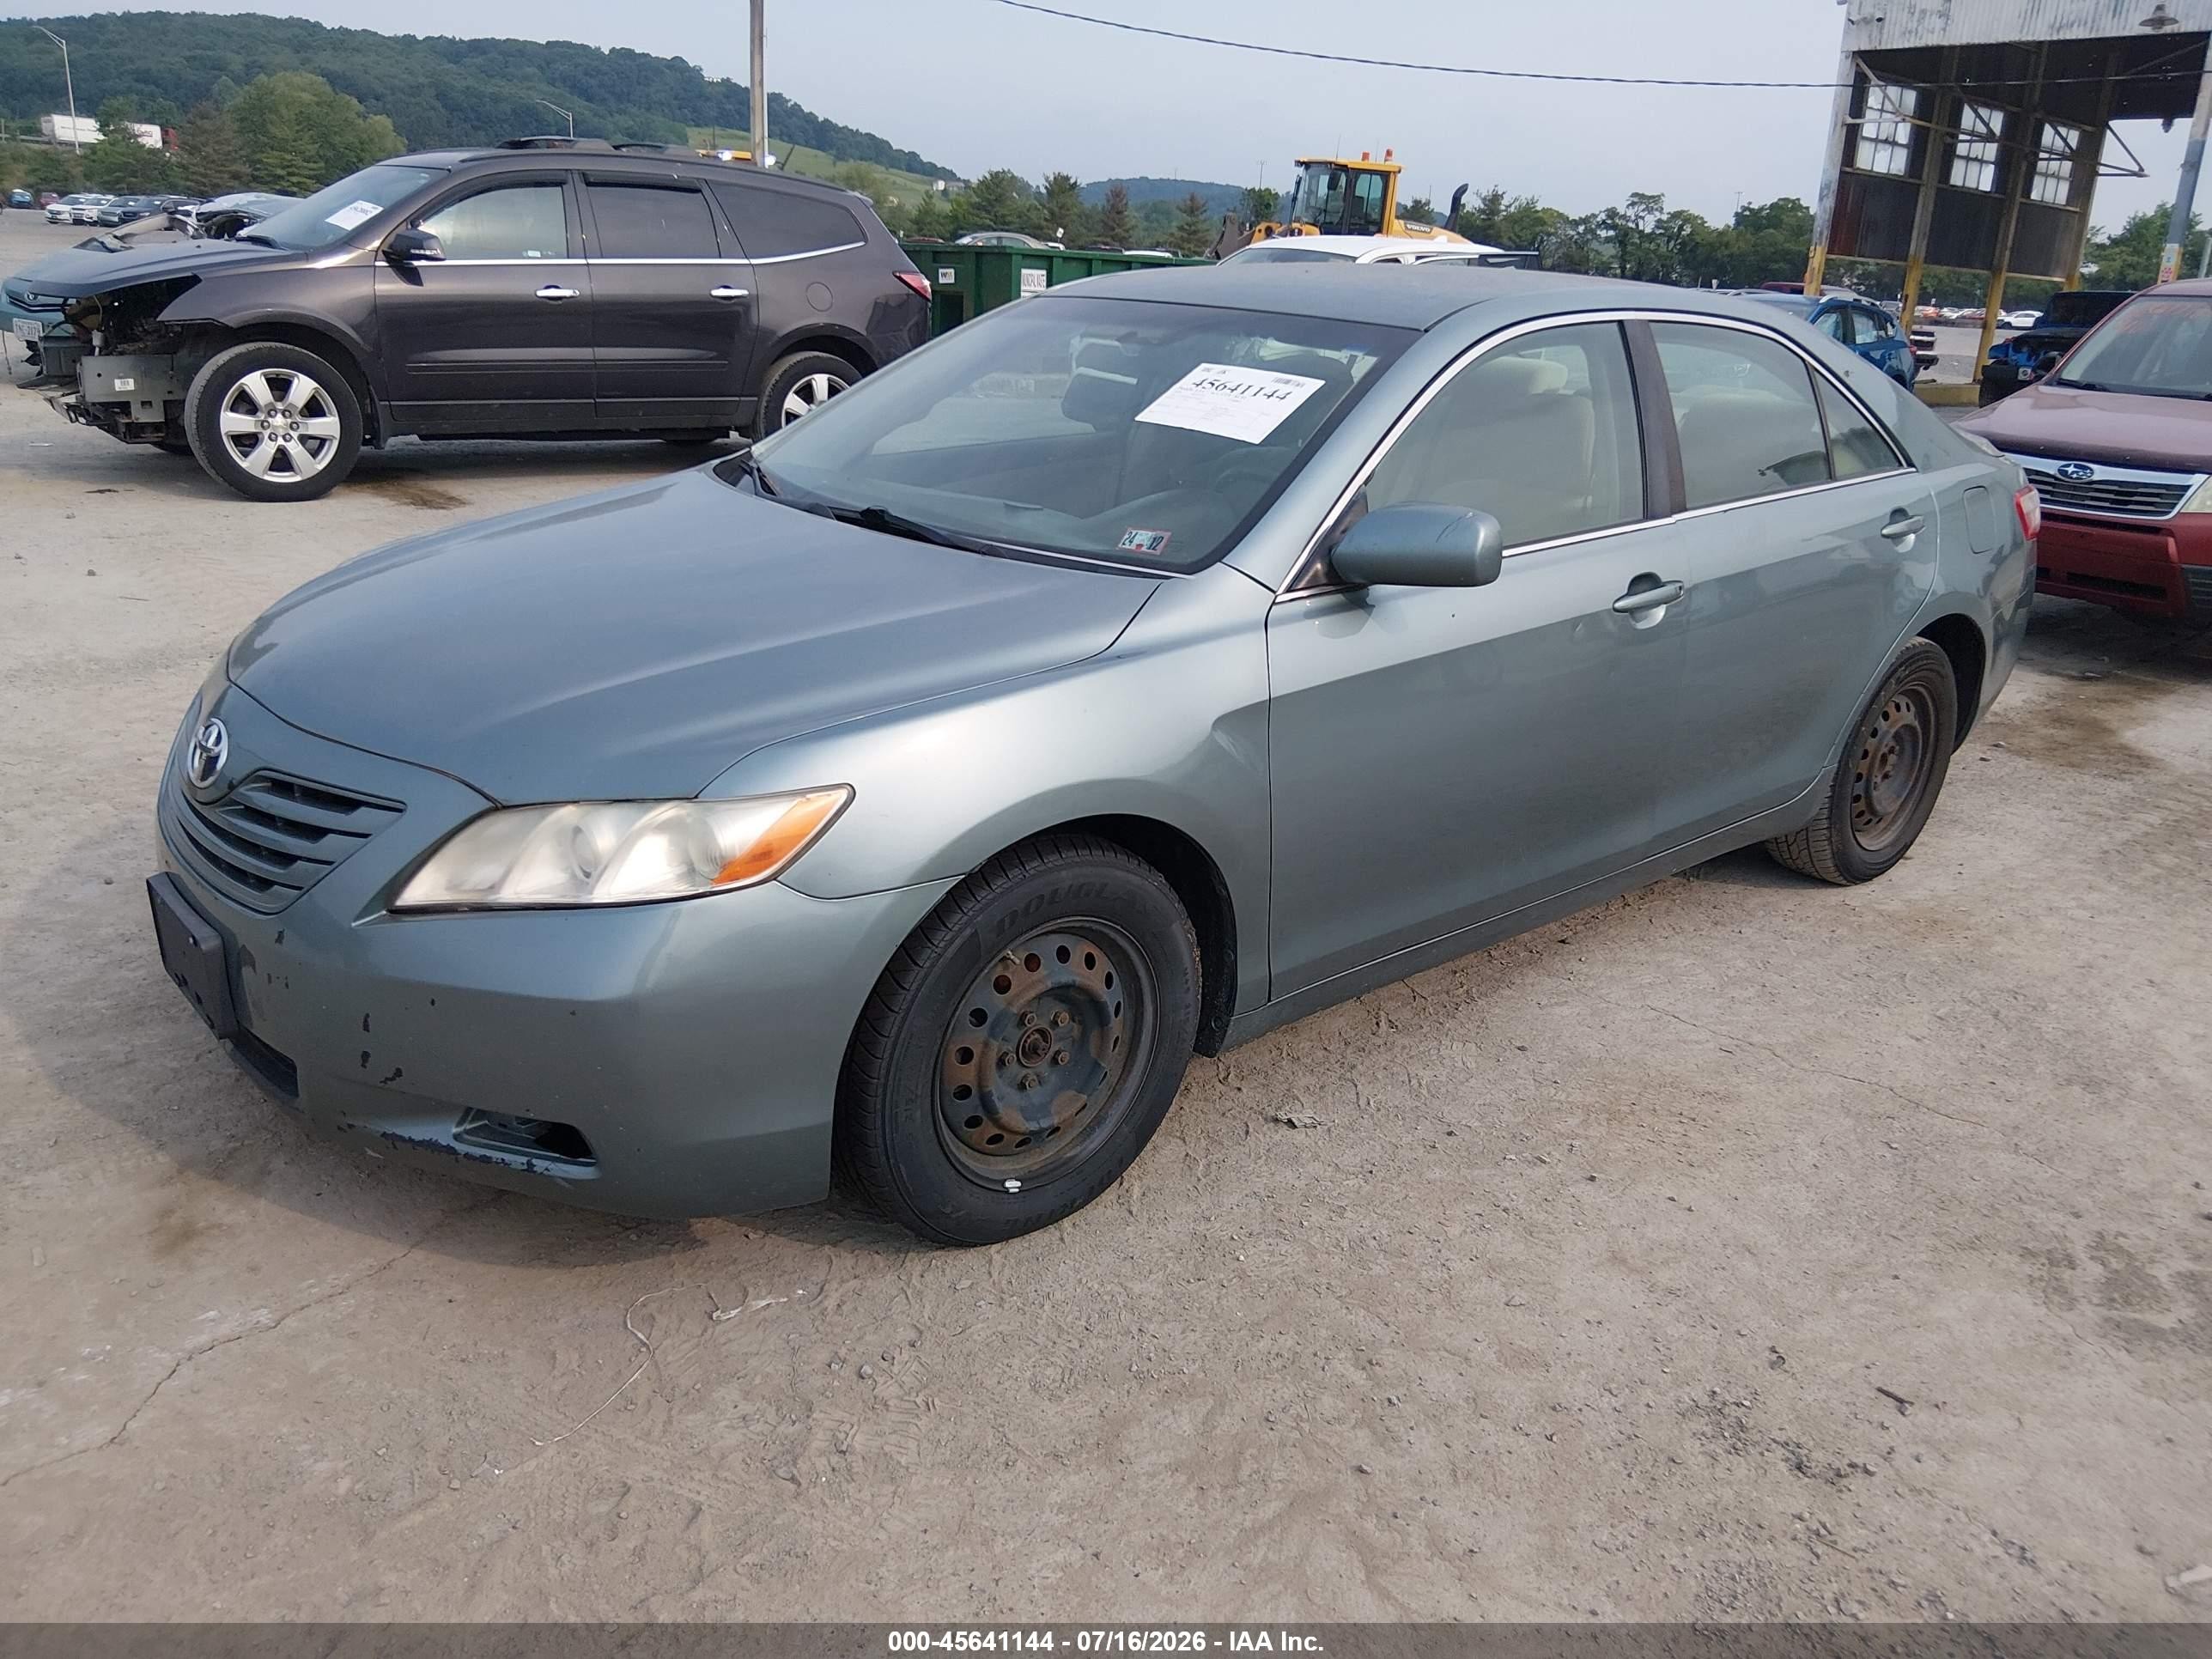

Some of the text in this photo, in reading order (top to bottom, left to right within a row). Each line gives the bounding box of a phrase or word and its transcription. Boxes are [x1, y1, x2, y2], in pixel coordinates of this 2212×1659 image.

[1407, 224, 1431, 233] VOLVO
[1191, 376, 1294, 402] 45641144
[1121, 531, 1164, 551] 24 12
[995, 881, 1162, 937] DOUGLAS
